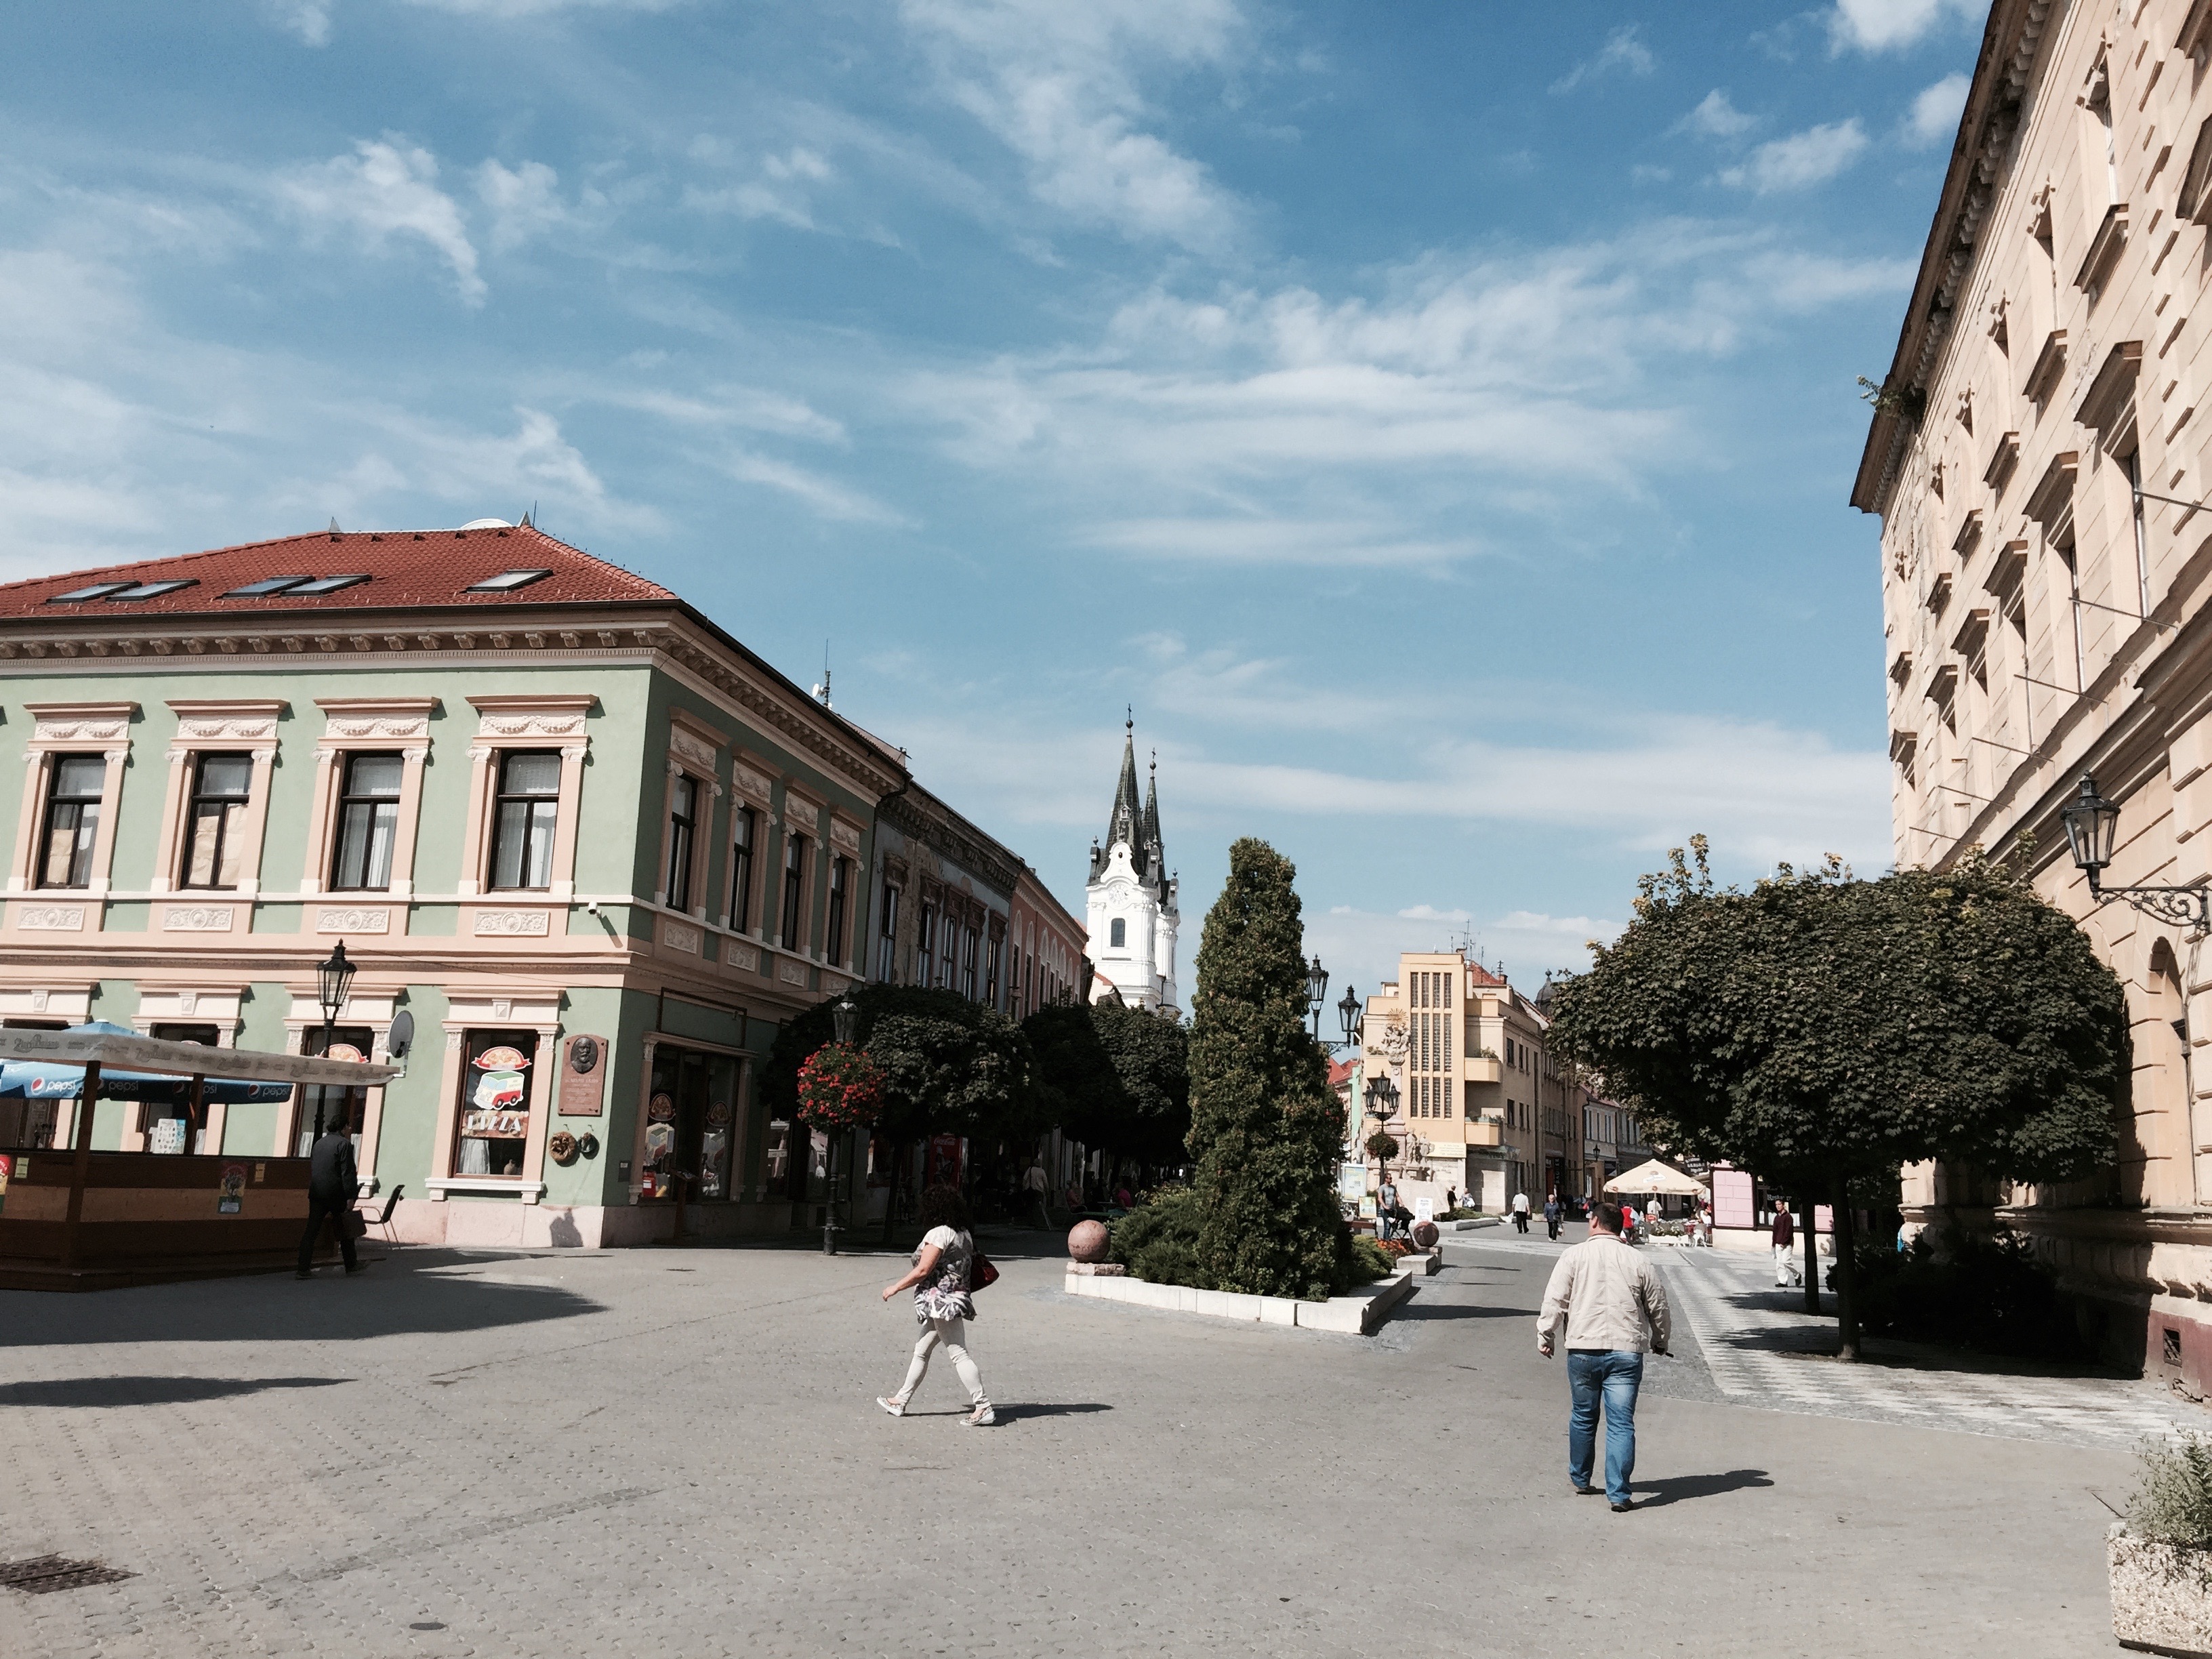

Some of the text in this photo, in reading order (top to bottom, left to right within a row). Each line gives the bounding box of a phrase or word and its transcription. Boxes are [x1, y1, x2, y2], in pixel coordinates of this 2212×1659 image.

[45, 1079, 77, 1092] pepsi
[108, 1081, 139, 1092] pepsi
[262, 1086, 289, 1098] pepsi
[467, 1115, 521, 1131] PIZZA
